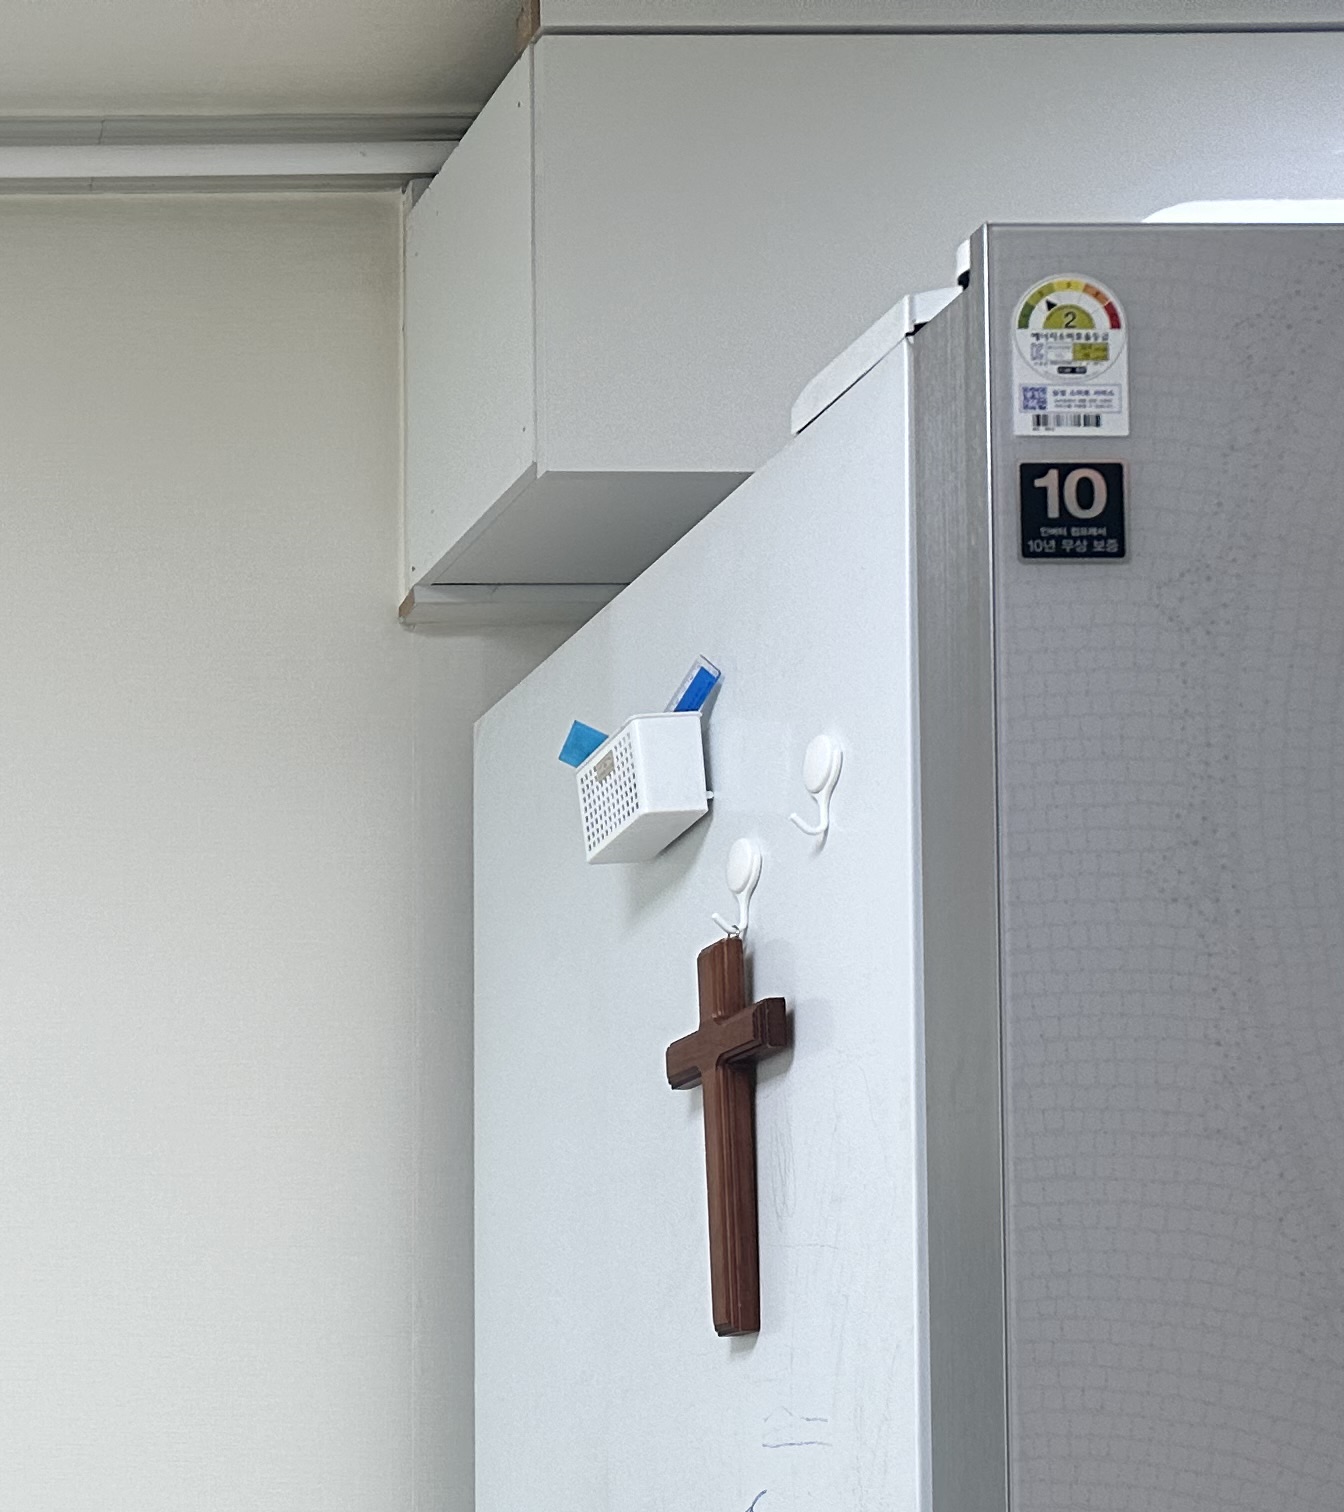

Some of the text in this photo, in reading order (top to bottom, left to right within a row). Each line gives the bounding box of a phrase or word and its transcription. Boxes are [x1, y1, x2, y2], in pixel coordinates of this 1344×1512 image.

[1063, 311, 1078, 329] 2
[1033, 467, 1108, 519] 10
[1027, 538, 1119, 553] 10년 무상 보증
